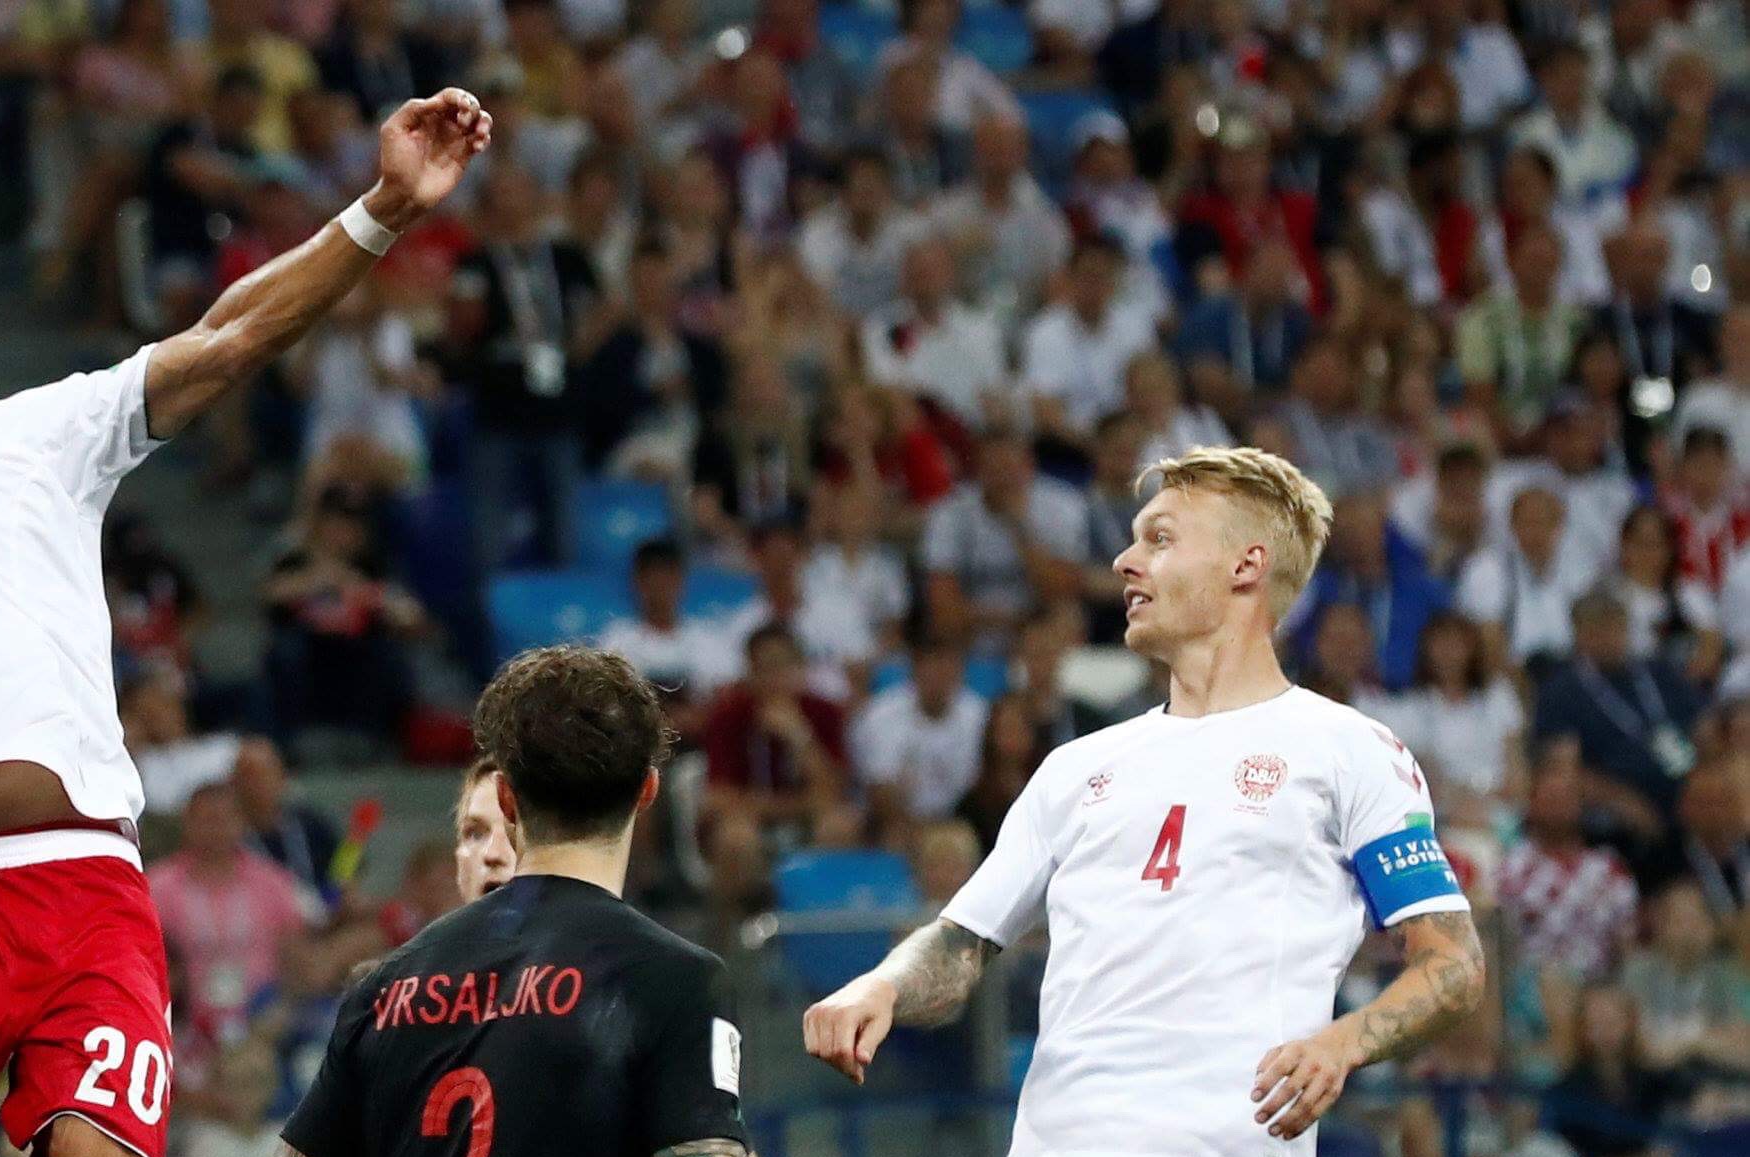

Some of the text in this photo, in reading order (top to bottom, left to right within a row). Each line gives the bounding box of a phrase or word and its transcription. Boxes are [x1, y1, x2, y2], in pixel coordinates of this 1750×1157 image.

[1141, 804, 1187, 892] 4
[373, 965, 583, 1032] VRSALJKO
[73, 1026, 167, 1125] 20
